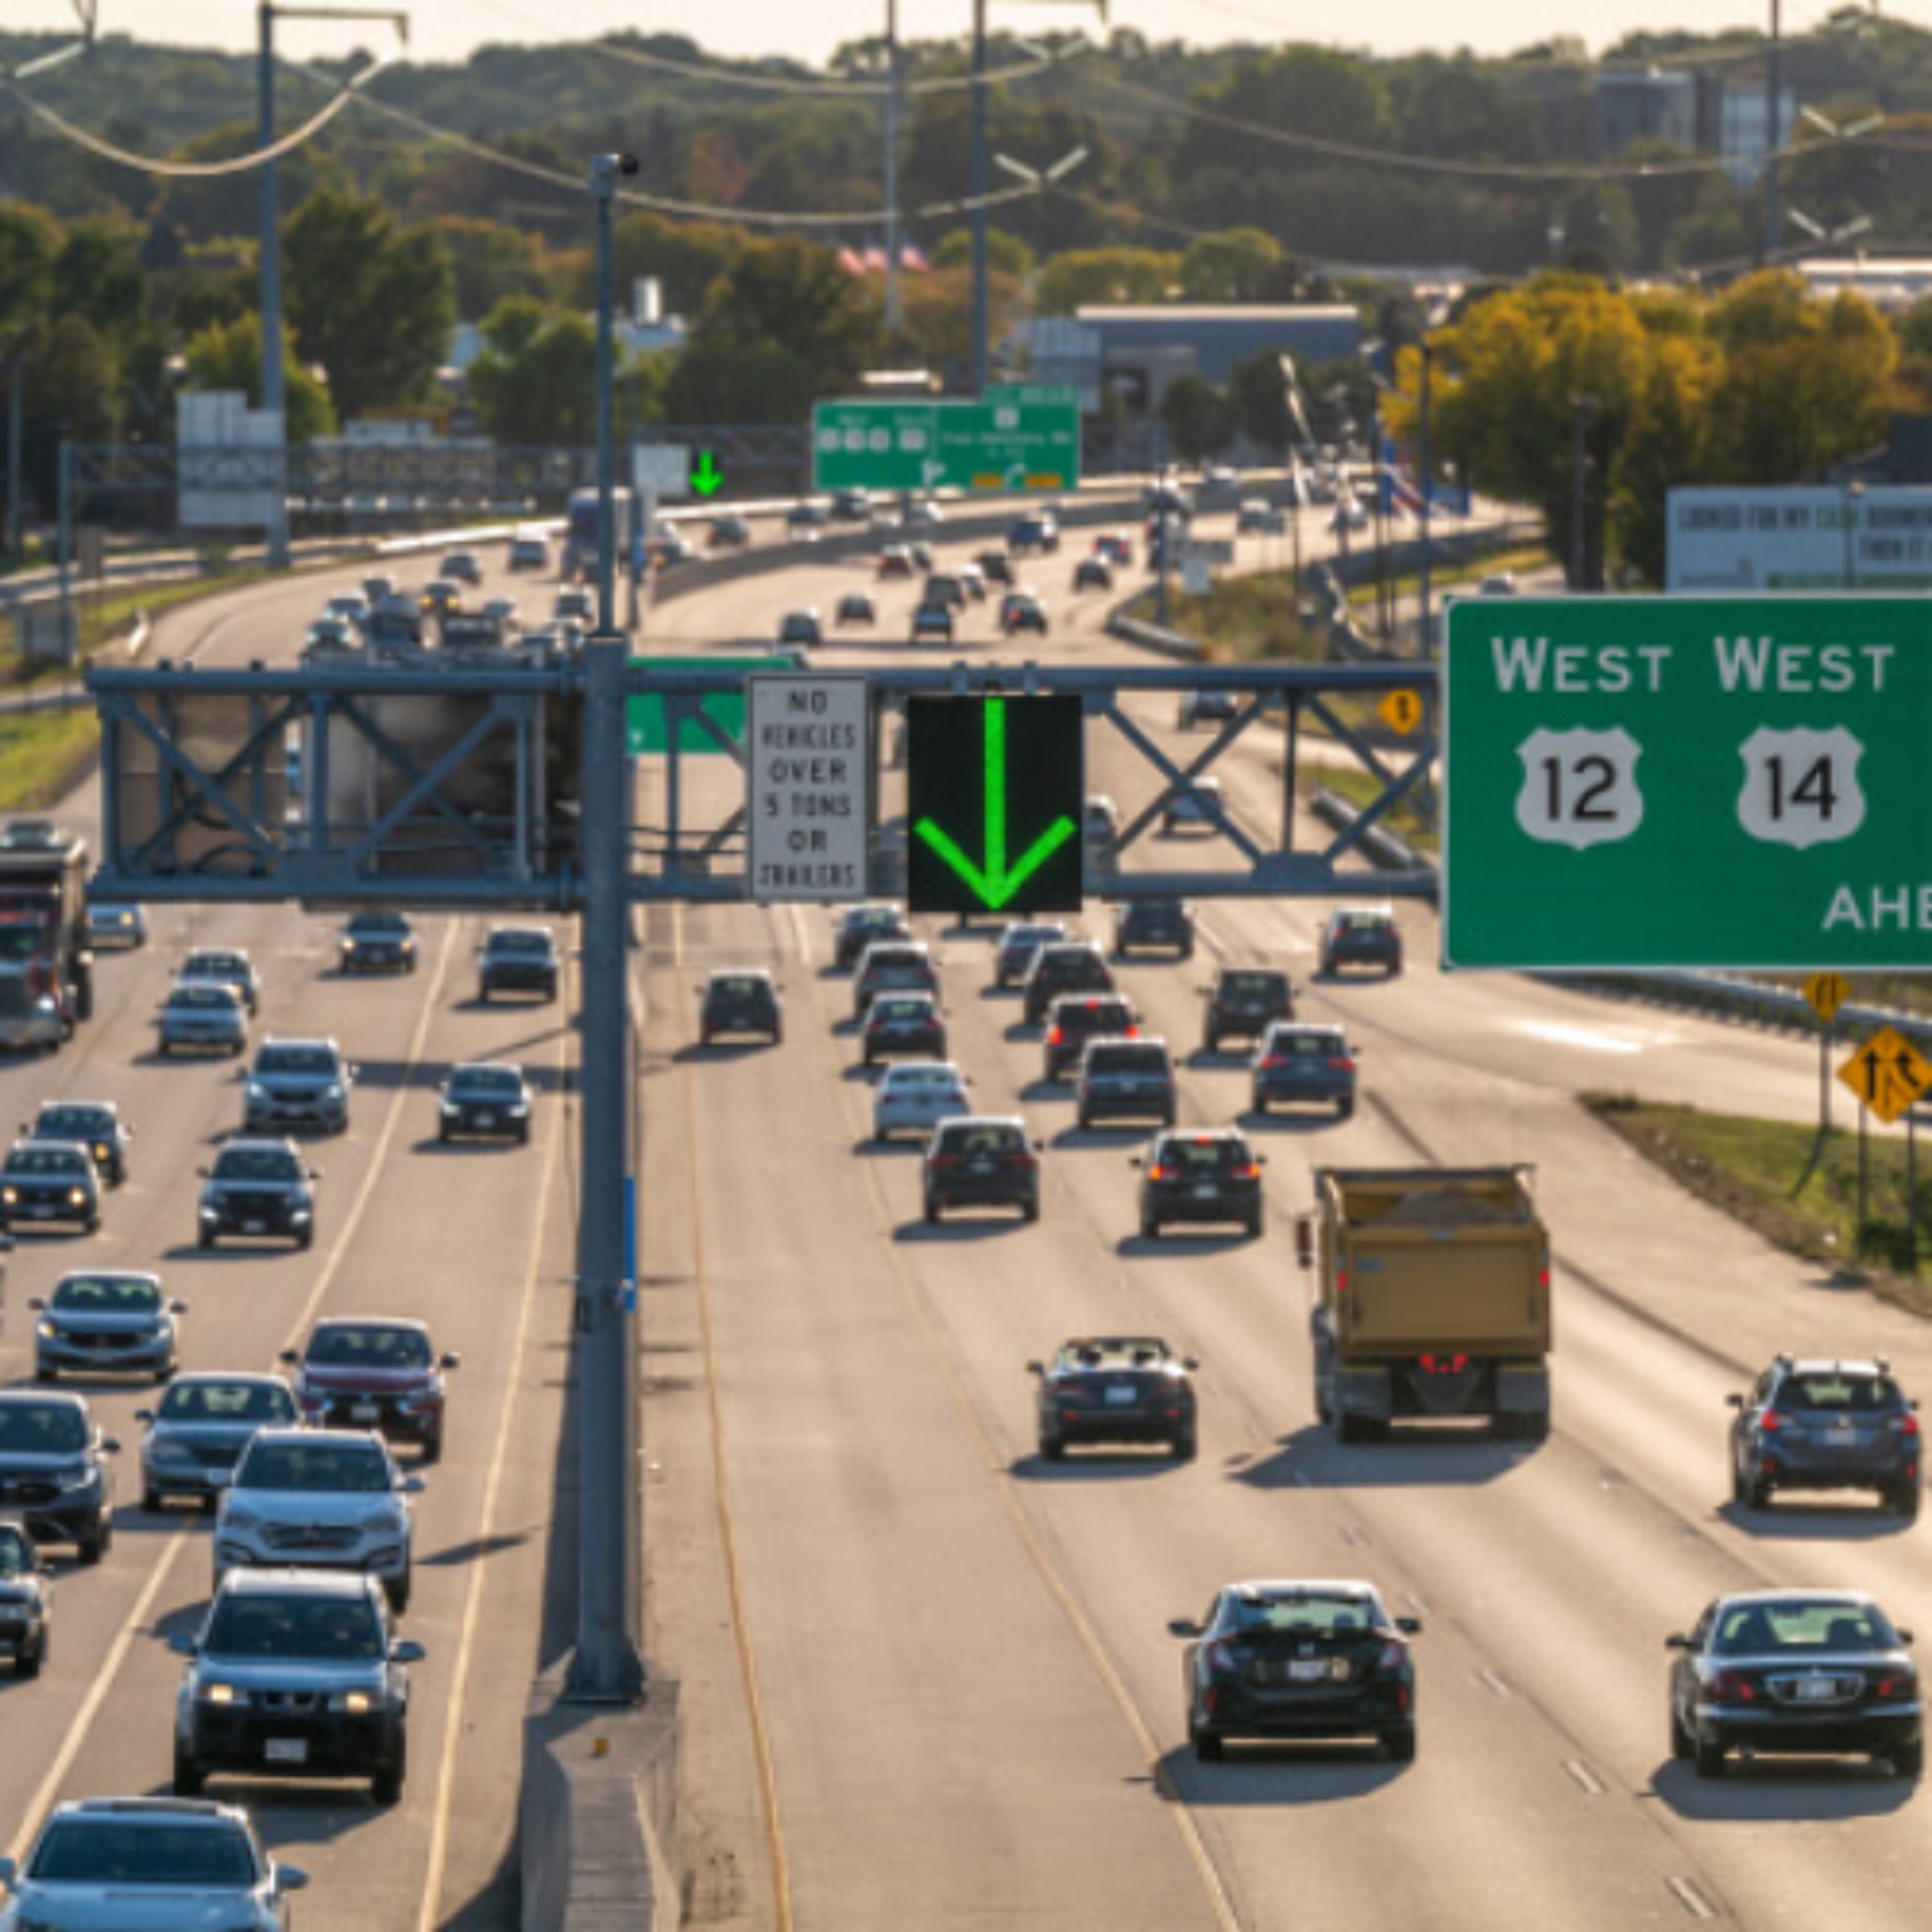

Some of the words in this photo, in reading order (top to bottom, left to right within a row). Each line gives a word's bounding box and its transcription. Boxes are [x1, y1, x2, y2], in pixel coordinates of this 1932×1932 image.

[1491, 636, 1672, 692] WEST
[1714, 636, 1895, 692] WEST
[788, 689, 828, 713] NO
[762, 723, 855, 750] VEHICLES
[770, 757, 846, 783] OVER
[1542, 755, 1617, 822] 12
[1765, 755, 1837, 822] 14
[790, 793, 851, 817] TONS
[788, 828, 828, 852] OR
[759, 864, 855, 888] TRAILERS
